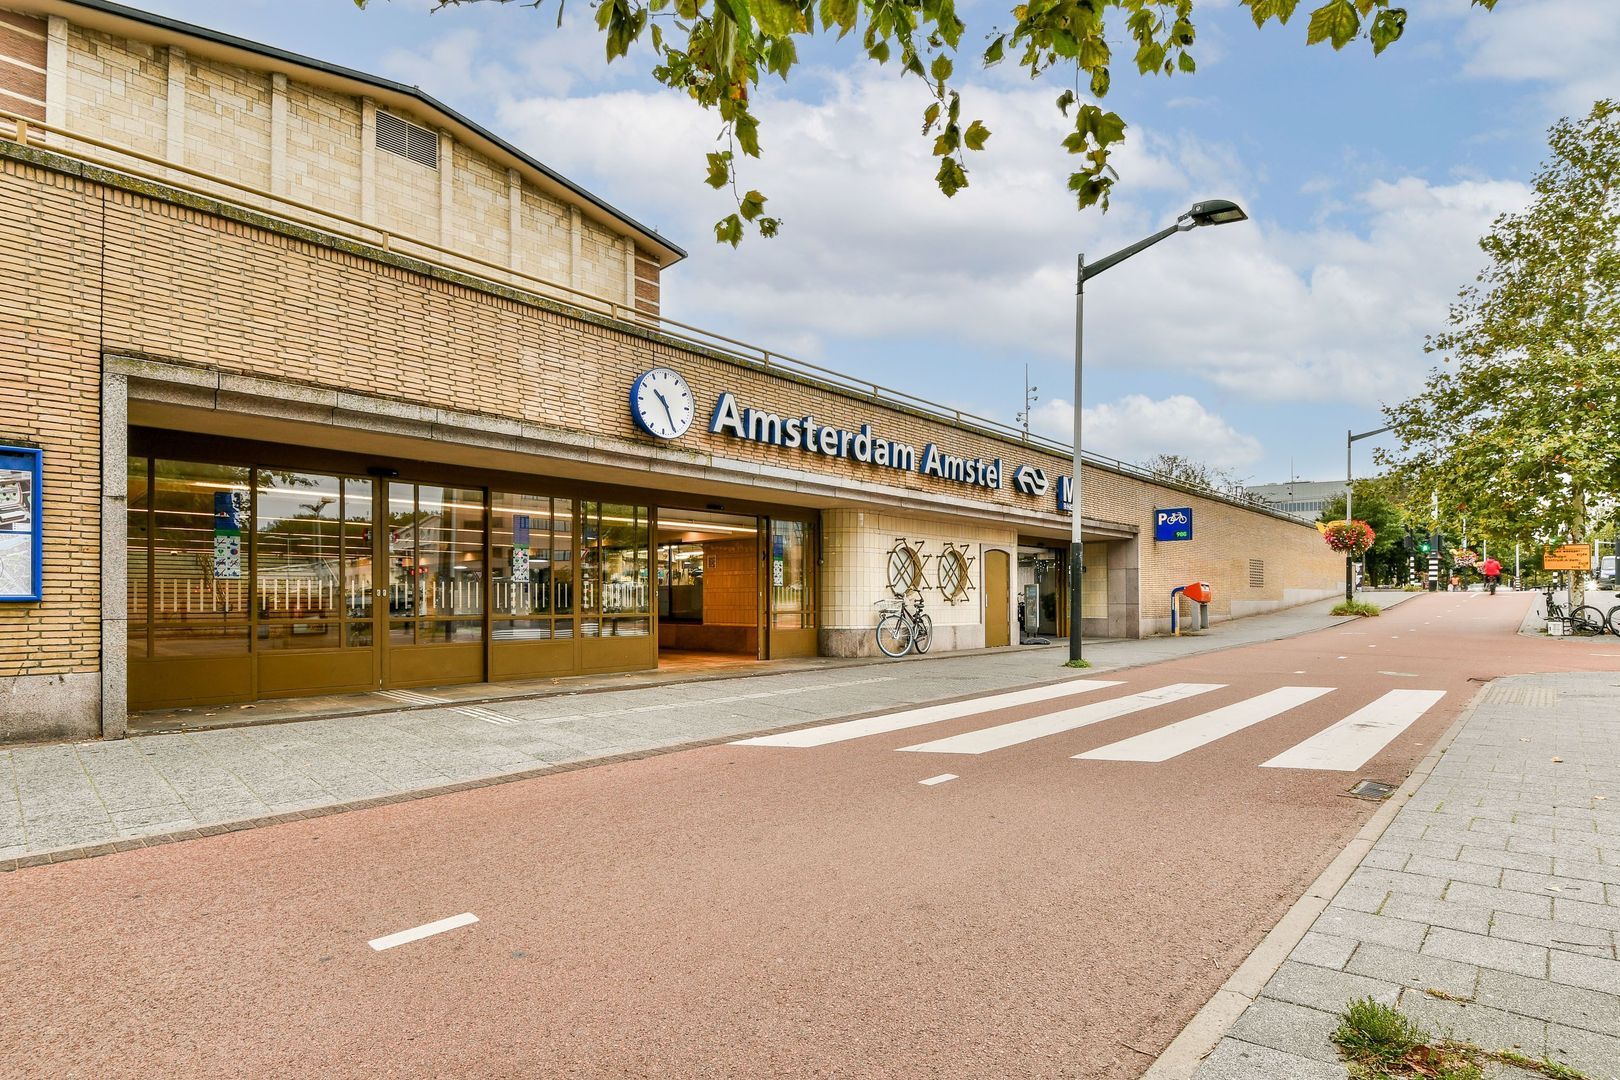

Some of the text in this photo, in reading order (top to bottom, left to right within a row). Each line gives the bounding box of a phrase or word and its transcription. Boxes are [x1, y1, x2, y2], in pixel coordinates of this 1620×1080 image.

[710, 392, 1003, 489] Amsterdam Amstel
[1158, 513, 1168, 526] P
